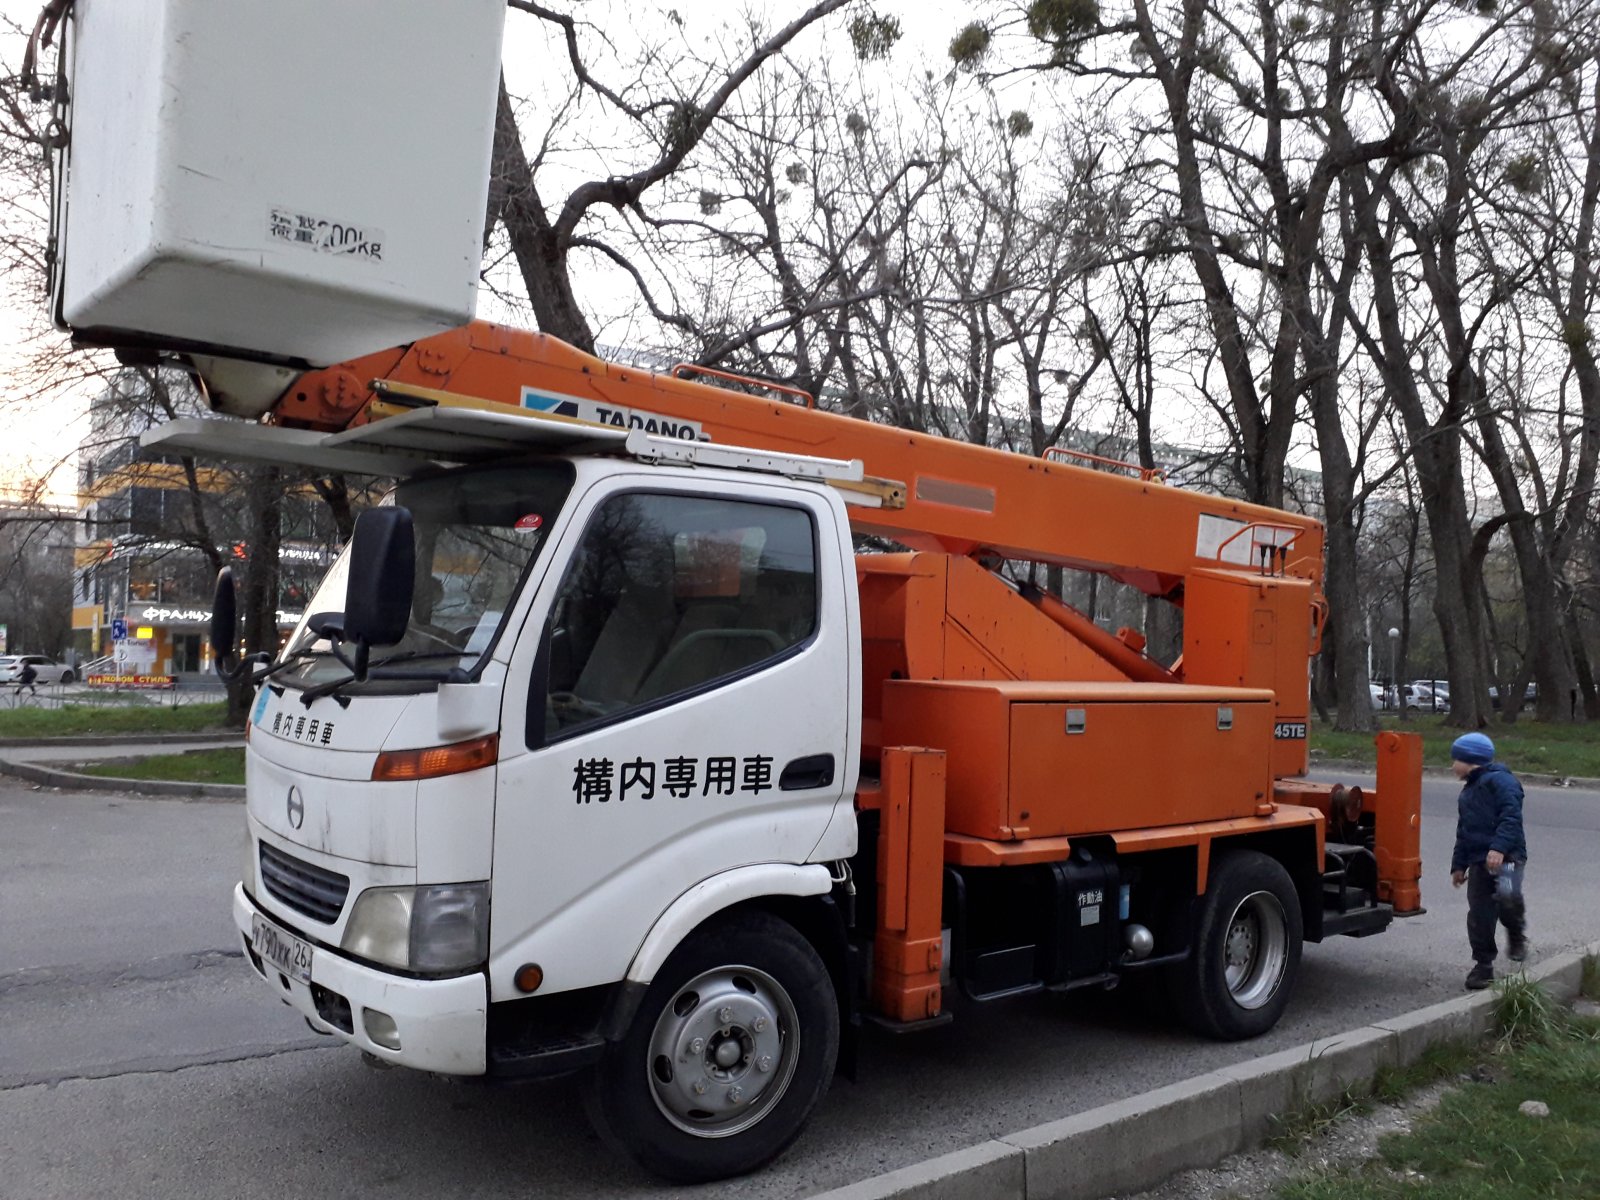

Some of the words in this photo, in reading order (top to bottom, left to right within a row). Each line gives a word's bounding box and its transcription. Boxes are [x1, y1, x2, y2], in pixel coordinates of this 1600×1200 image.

[596, 407, 696, 441] TADANO
[1274, 723, 1306, 738] 45TE
[572, 754, 774, 804] 構内専用車
[294, 942, 307, 968] 26
